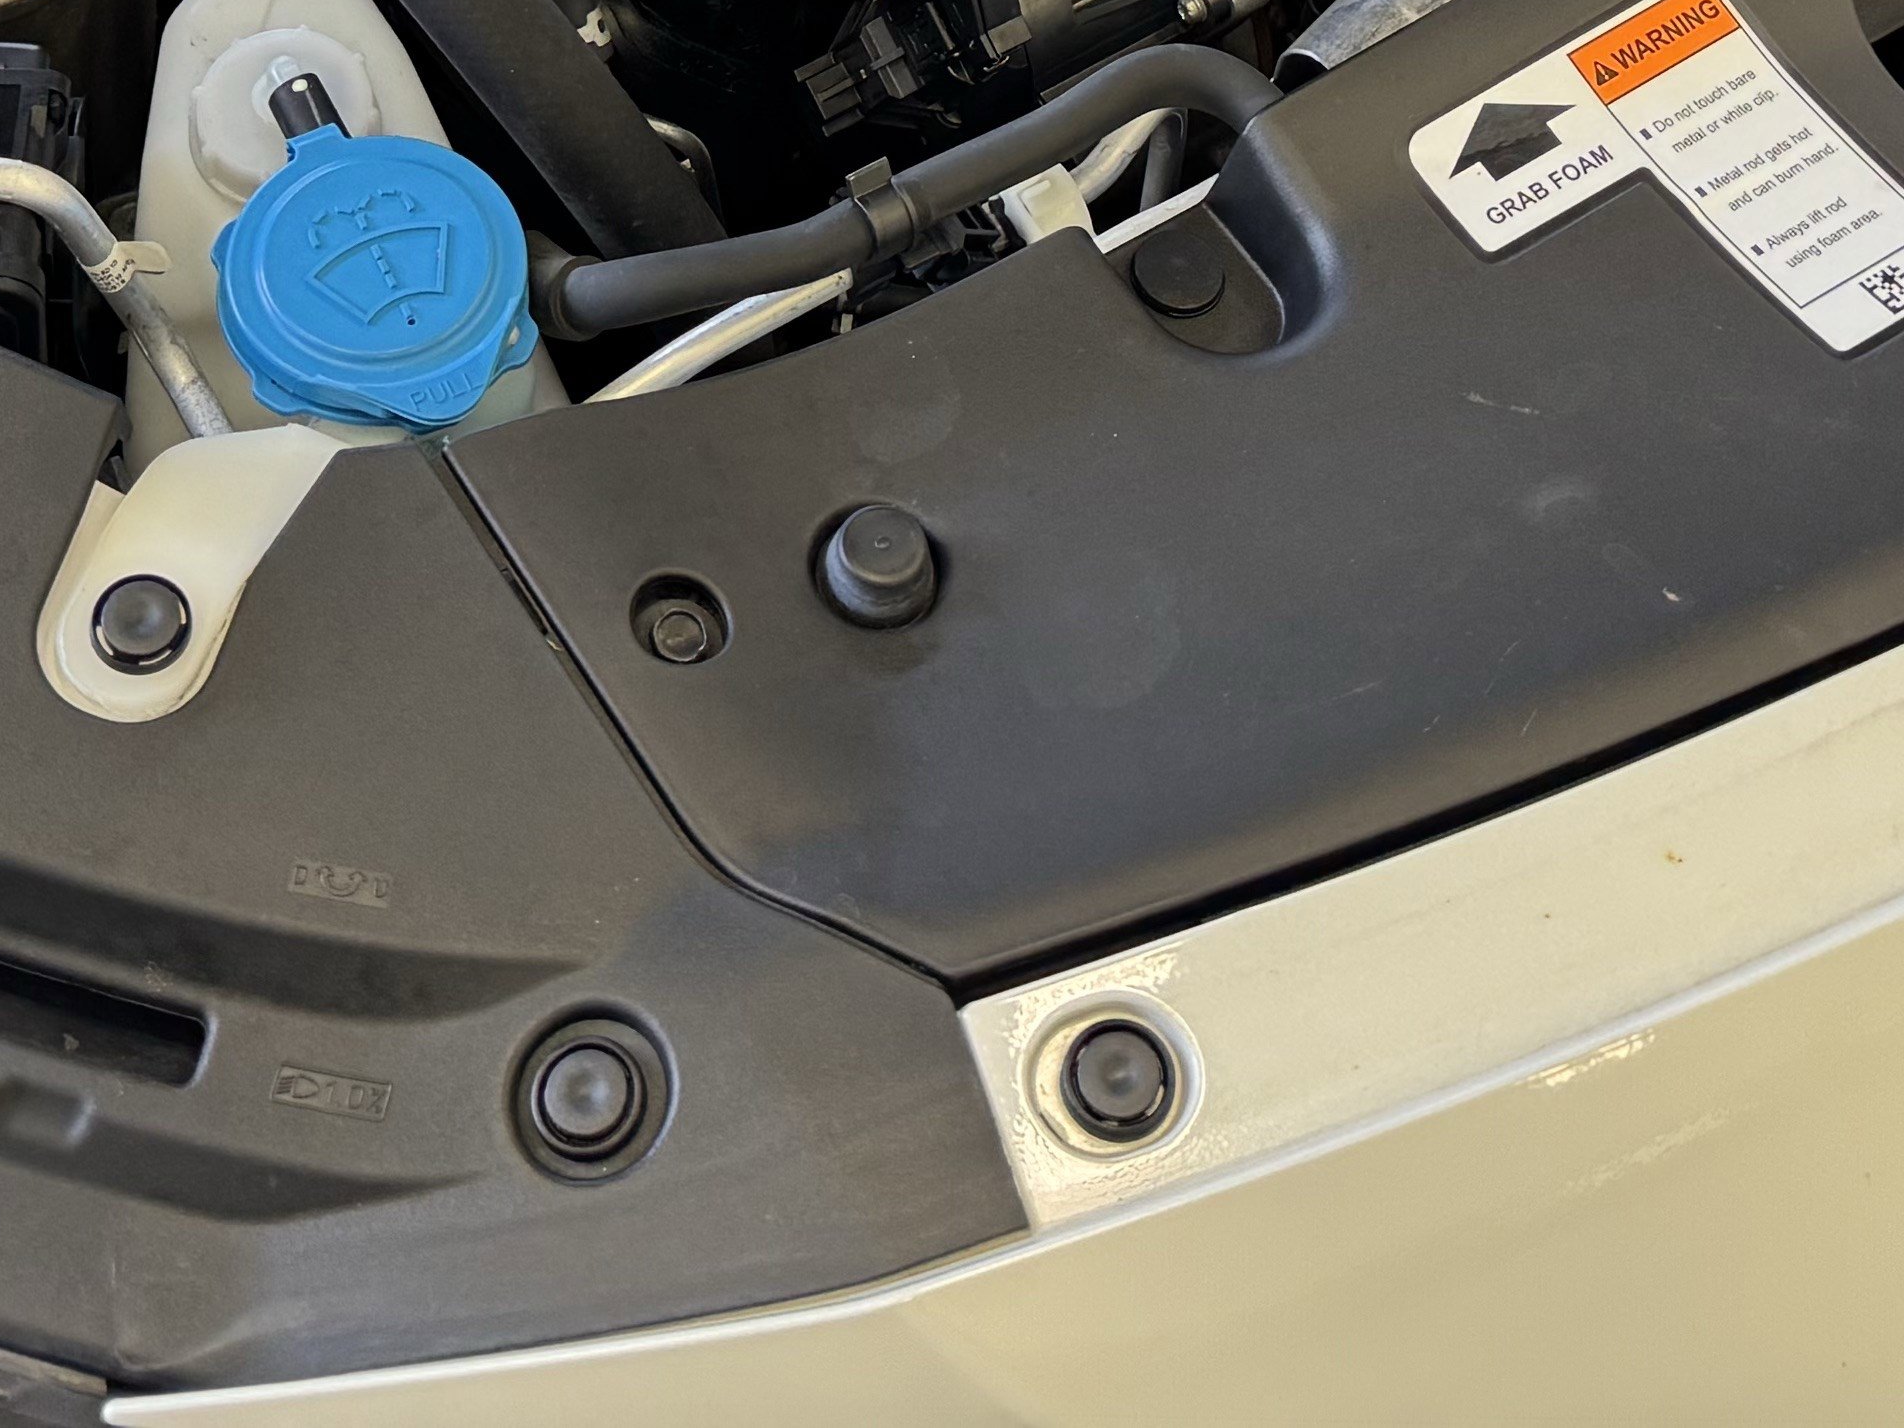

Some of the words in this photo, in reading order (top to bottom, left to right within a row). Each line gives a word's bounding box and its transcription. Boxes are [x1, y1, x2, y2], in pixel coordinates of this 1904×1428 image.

[1610, 0, 1721, 70] WARNING
[1652, 116, 1675, 133] Do
[1674, 104, 1696, 122] not
[1693, 85, 1730, 110] touch
[1726, 69, 1757, 91] bare
[1671, 126, 1708, 153] metal
[1706, 119, 1721, 134] or
[1720, 102, 1753, 125] white
[1753, 88, 1780, 106] clip.
[1486, 181, 1550, 225] GRAB
[1547, 144, 1614, 190] FOAM
[1707, 166, 1744, 192] Metal
[1743, 153, 1766, 173] rod
[1764, 139, 1792, 163] gets
[1789, 126, 1814, 144] hot
[1728, 190, 1753, 212] and
[1752, 179, 1778, 197] can
[1773, 162, 1805, 184] burn
[1800, 142, 1839, 167] hand.
[1765, 218, 1810, 250] Always
[1807, 208, 1827, 226] lift
[1825, 196, 1848, 216] rod
[1785, 243, 1822, 269] using
[1817, 226, 1853, 249] foam
[1850, 207, 1884, 230] area.
[408, 372, 484, 413] PULL
